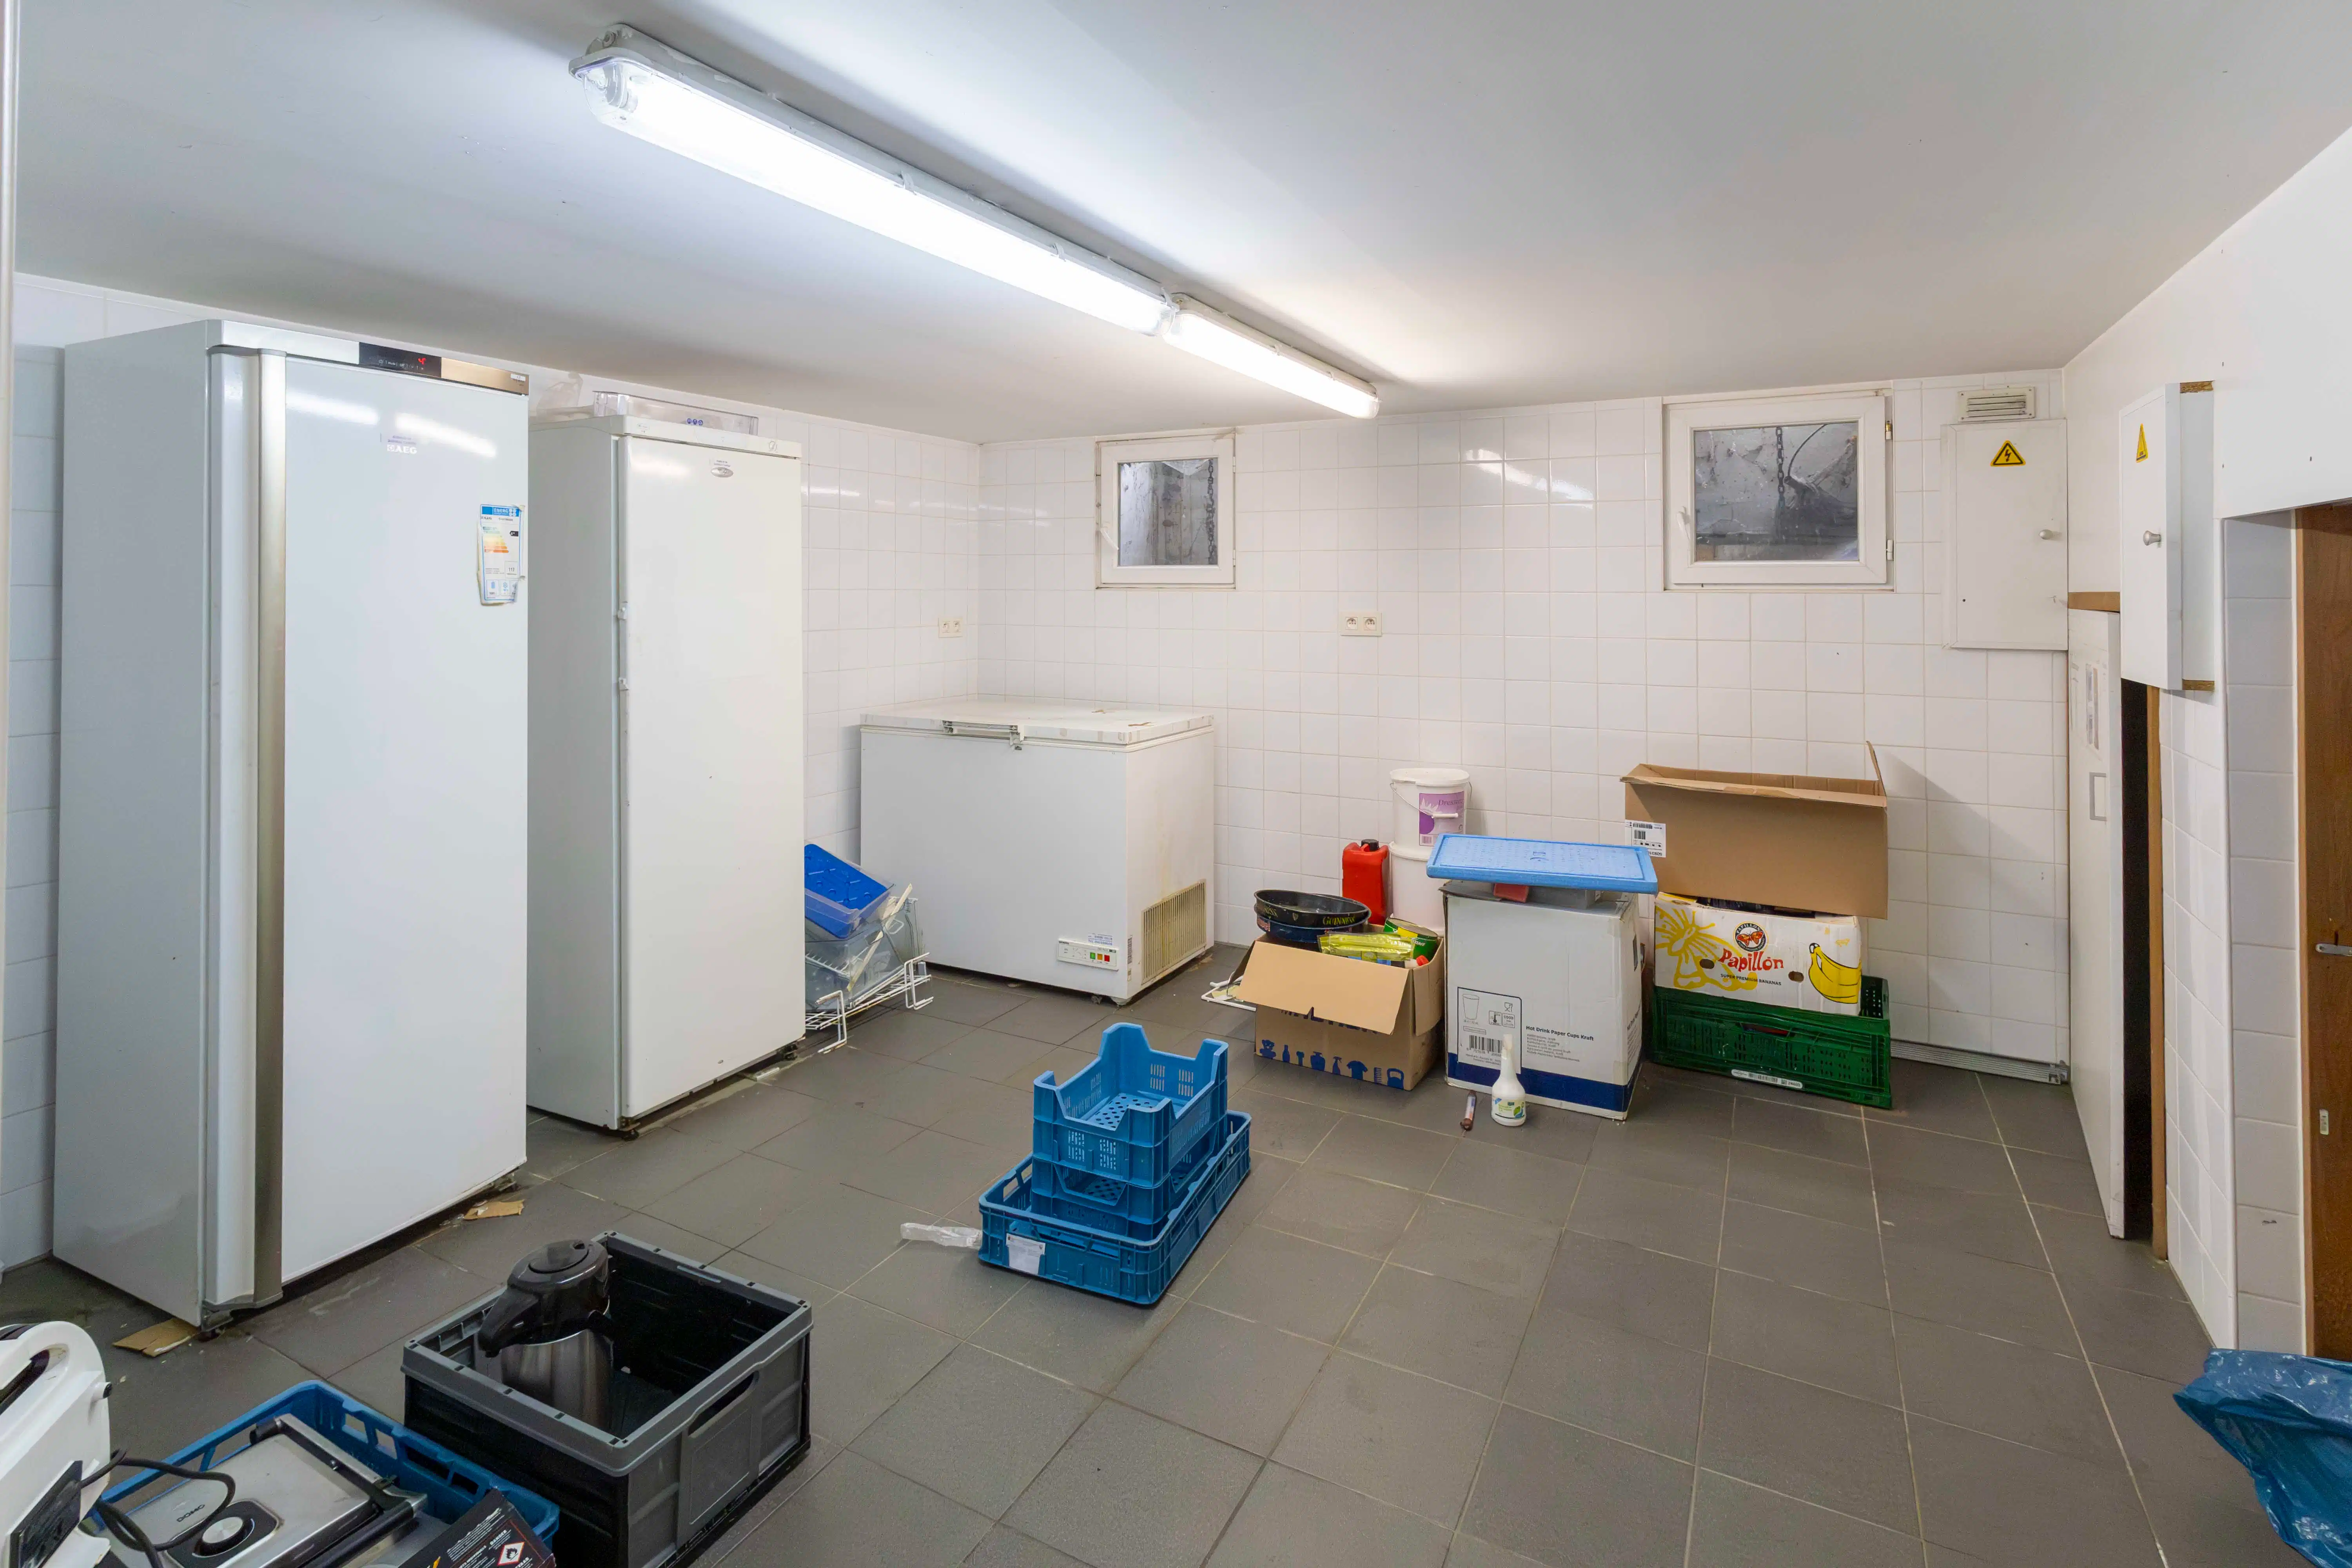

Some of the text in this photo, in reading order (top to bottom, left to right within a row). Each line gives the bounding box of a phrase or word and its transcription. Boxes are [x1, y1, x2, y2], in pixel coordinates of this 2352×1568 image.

[395, 445, 417, 454] AEG
[1737, 924, 1760, 933] PAPILLON
[176, 1504, 205, 1522] DOMO
